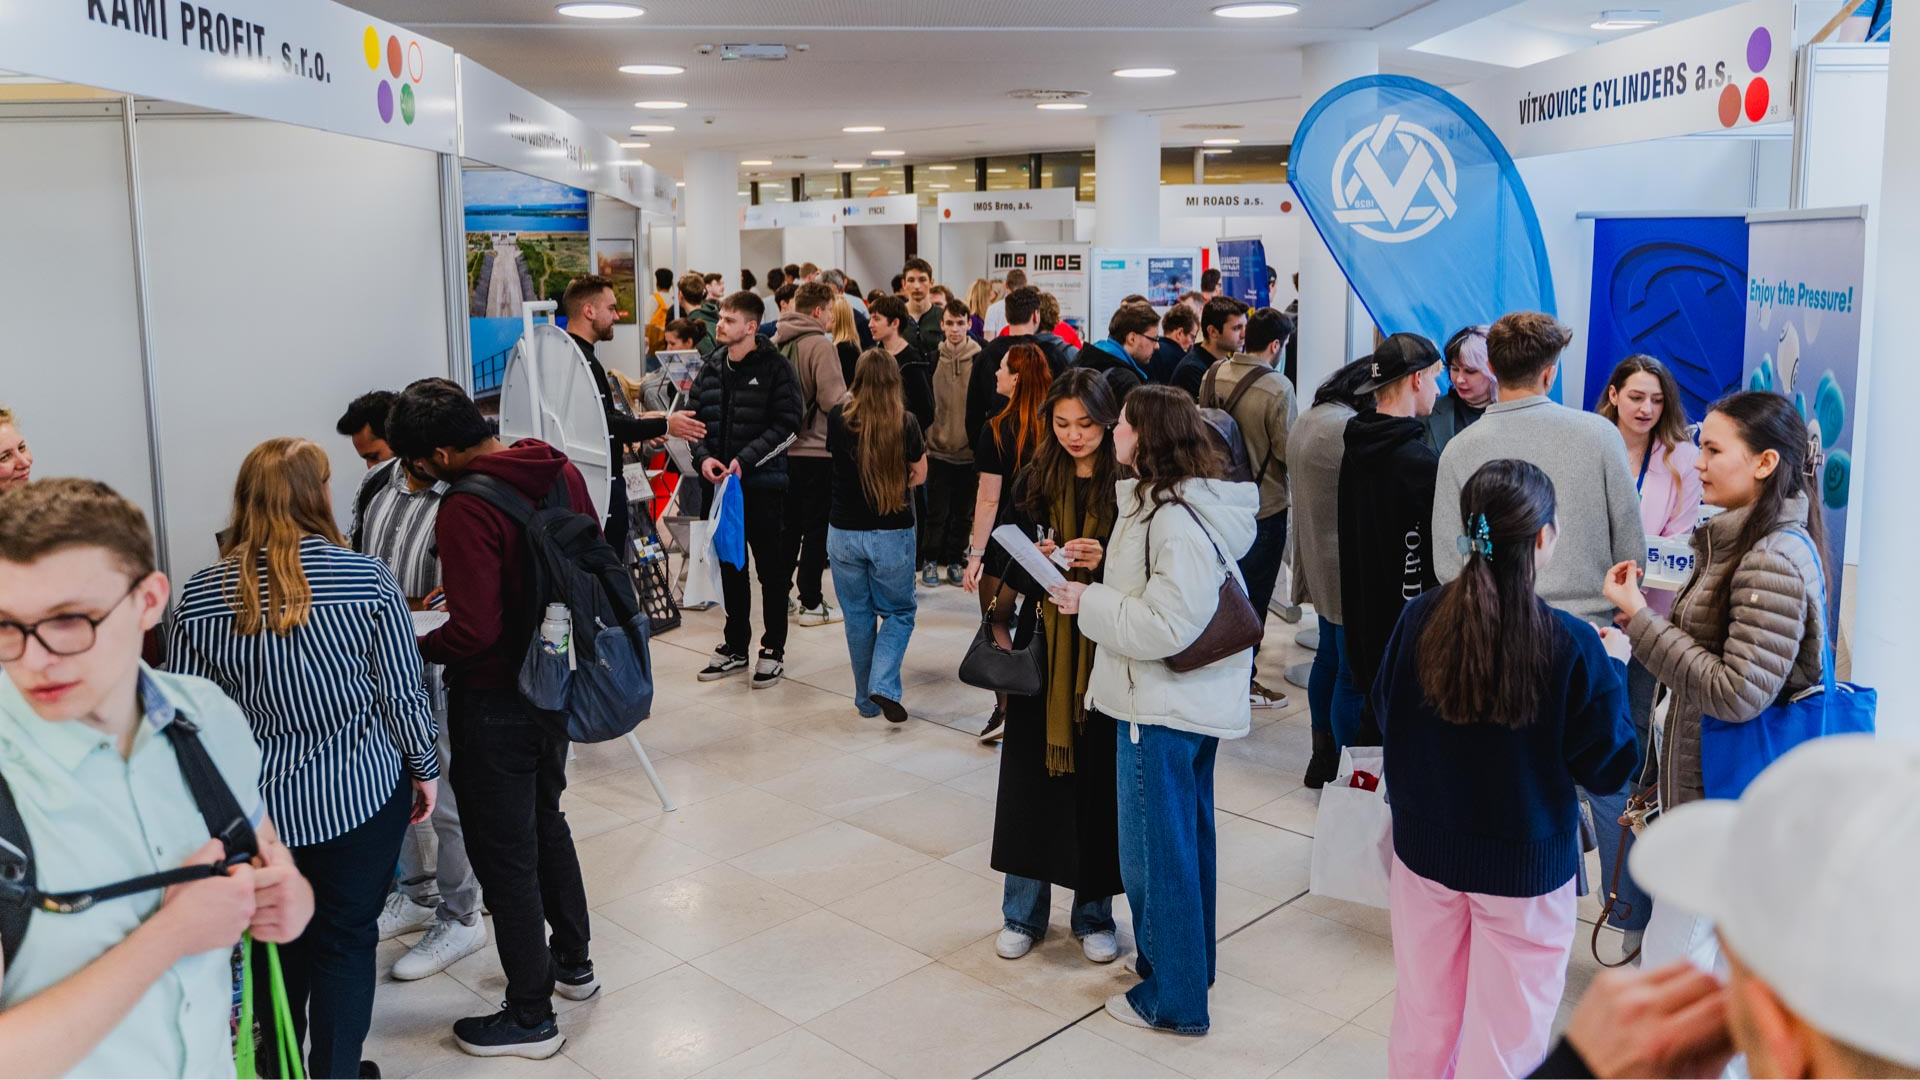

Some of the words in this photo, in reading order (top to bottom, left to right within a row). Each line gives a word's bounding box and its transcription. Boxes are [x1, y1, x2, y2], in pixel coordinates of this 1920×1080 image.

[281, 42, 331, 83] s.r.o.
[1519, 85, 1587, 125] VÍTKOVICE
[1593, 62, 1687, 111] CYLINDERS
[1695, 61, 1732, 91] a.s.
[973, 202, 993, 211] IMOS
[995, 201, 1016, 212] Brno,
[1018, 202, 1033, 210] a.s.
[1186, 196, 1199, 206] MI
[1203, 196, 1240, 206] ROADS
[1243, 197, 1264, 206] a.s.
[994, 253, 1027, 268] IMO
[1034, 254, 1081, 271] IMOS
[1749, 277, 1776, 309] Enjoy
[1777, 280, 1795, 306] the
[1797, 282, 1853, 313] Pressure!
